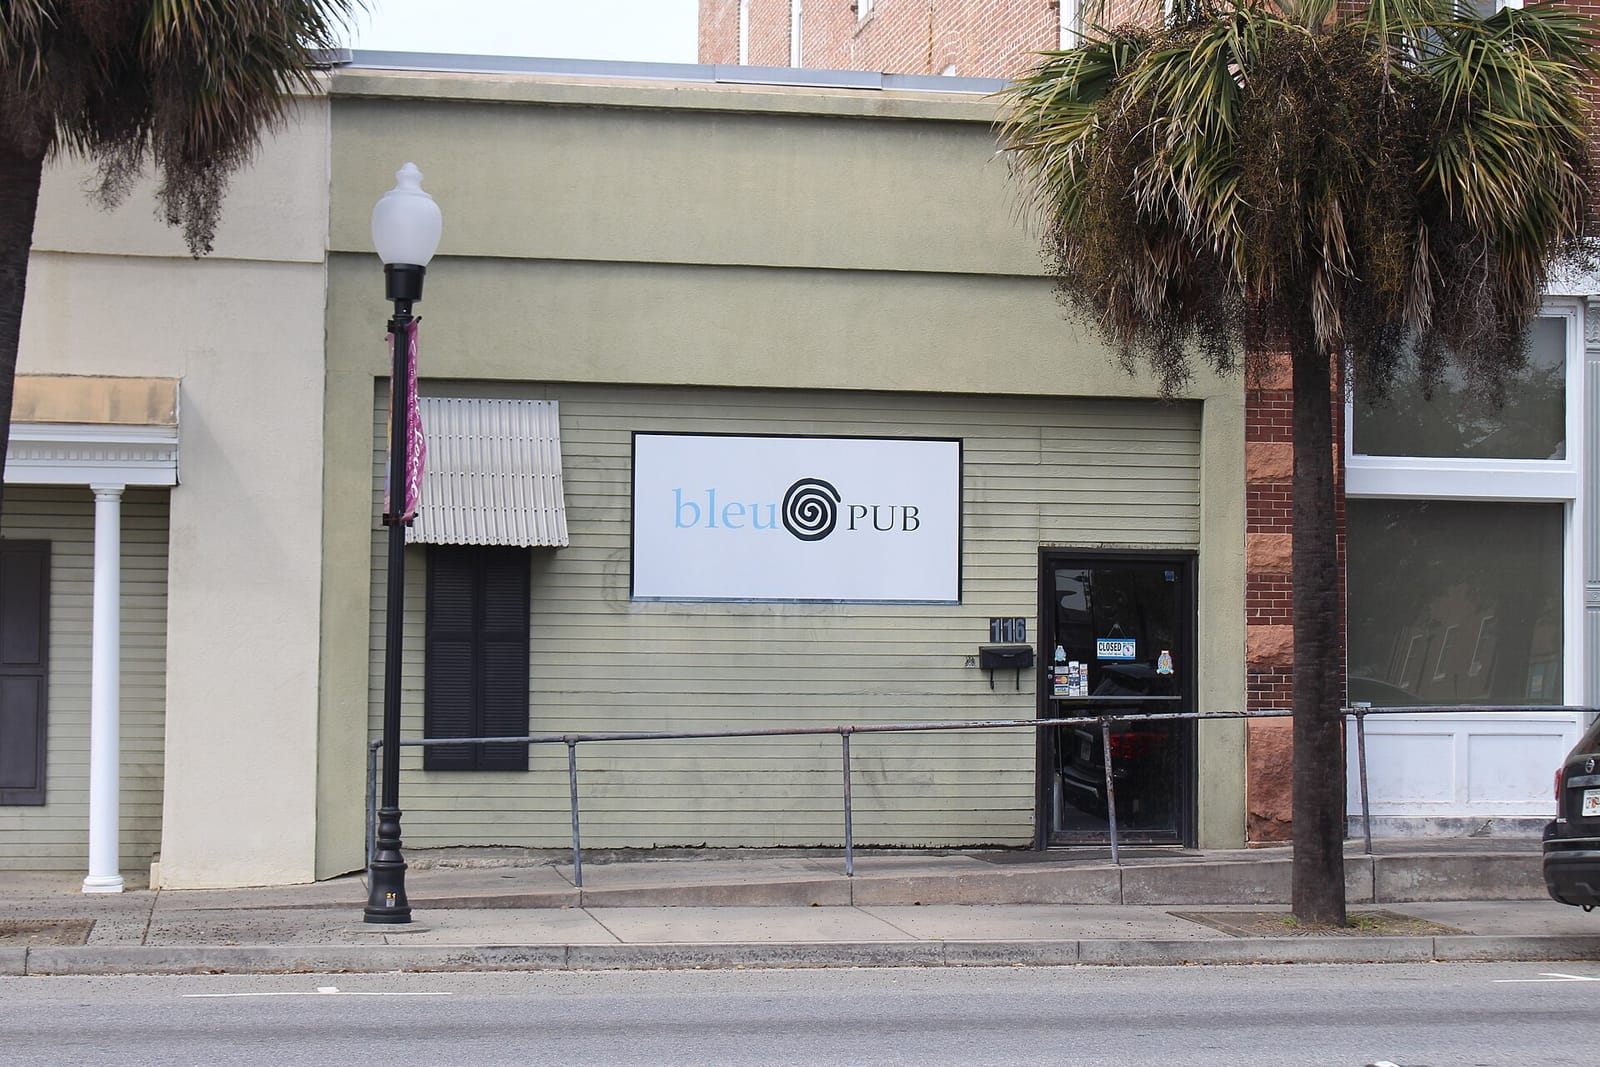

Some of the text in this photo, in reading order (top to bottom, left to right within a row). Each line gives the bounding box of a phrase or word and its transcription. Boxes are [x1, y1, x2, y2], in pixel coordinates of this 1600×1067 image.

[672, 488, 920, 532] bleu PUB
[991, 618, 1025, 642] 116
[1098, 642, 1122, 652] CLOSED
